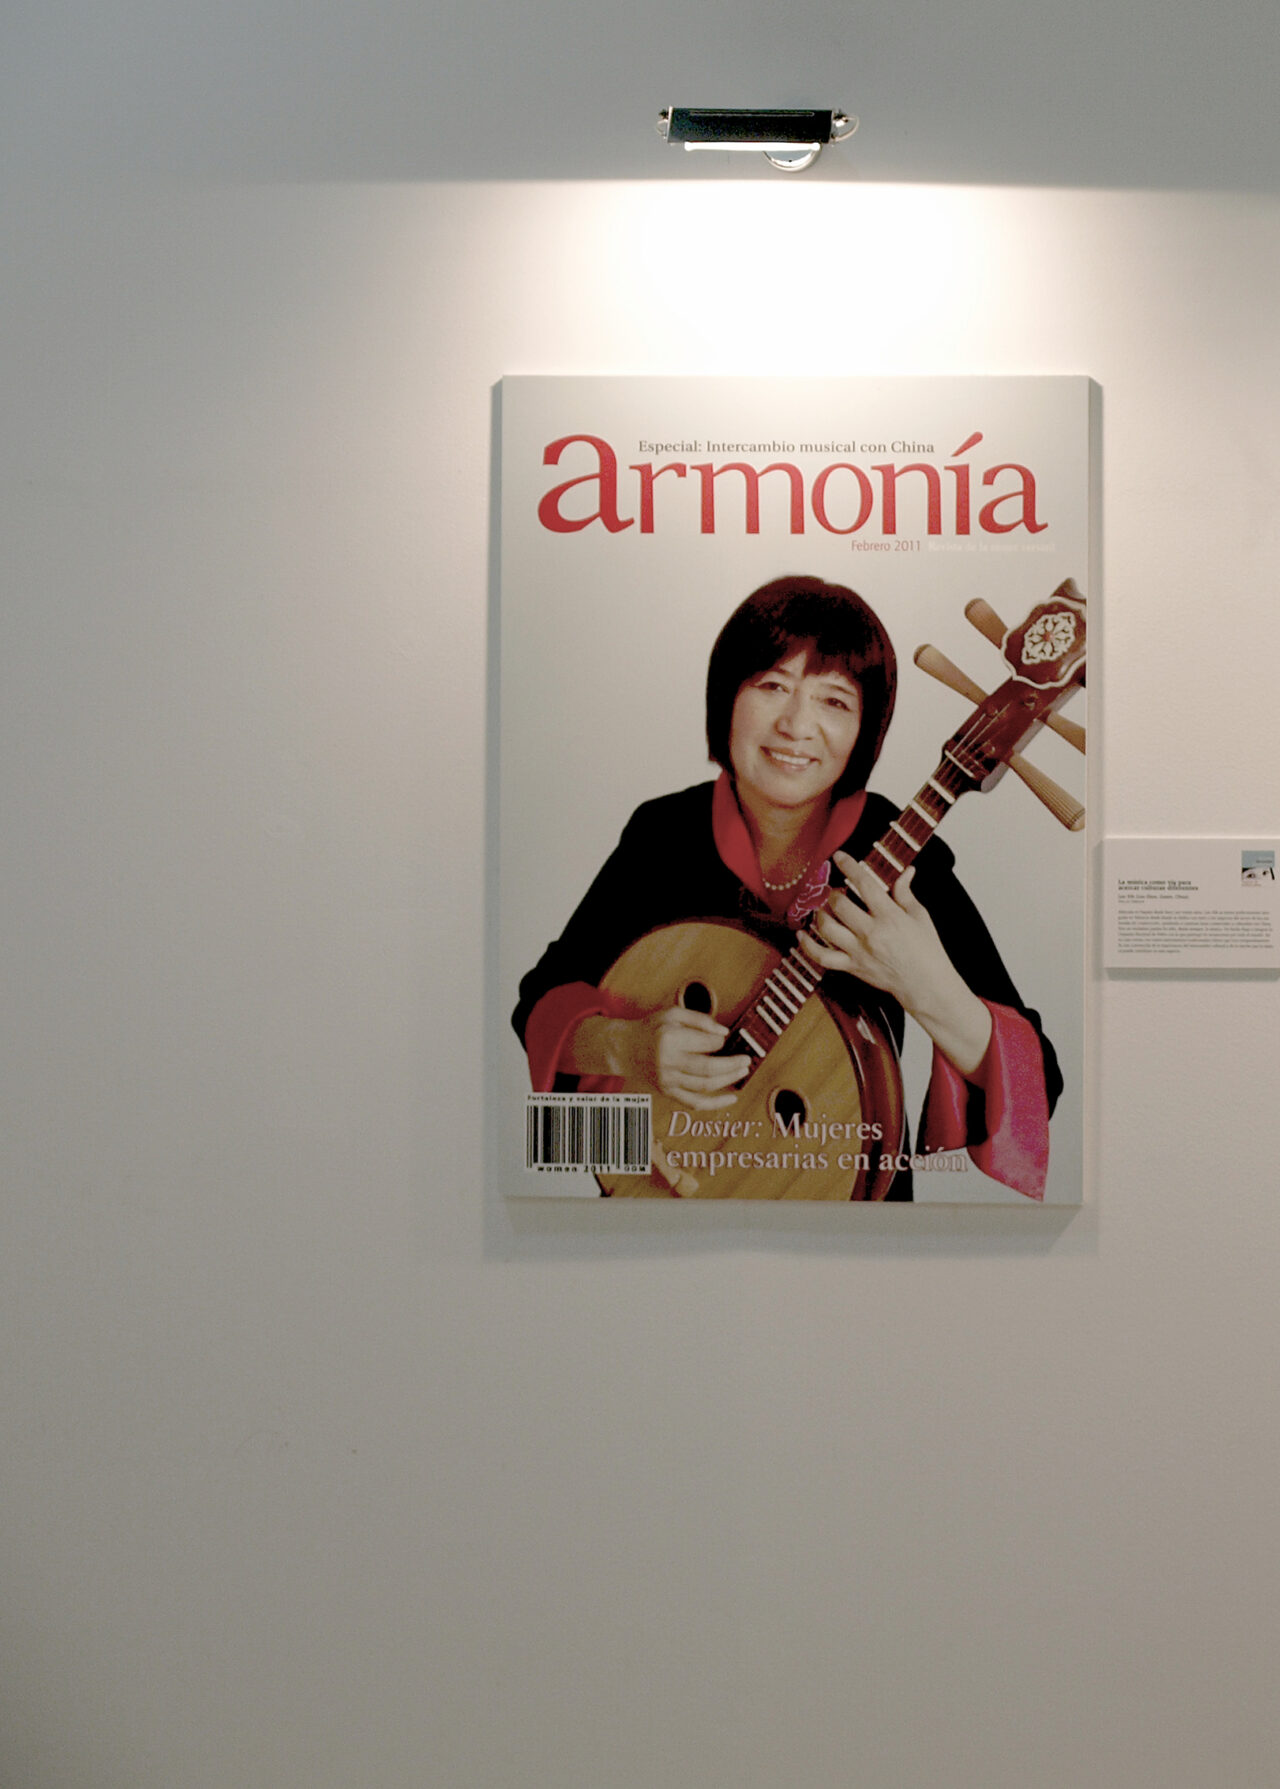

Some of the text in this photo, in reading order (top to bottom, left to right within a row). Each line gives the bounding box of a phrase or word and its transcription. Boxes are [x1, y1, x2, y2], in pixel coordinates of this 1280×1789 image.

[638, 439, 935, 455] Especial: Intercambio musical con China
[537, 431, 1049, 536] armonía
[851, 540, 921, 551] Febrero 2011
[668, 1111, 883, 1145] Dossier: Mujeres
[666, 1143, 968, 1176] empresarias en acción
